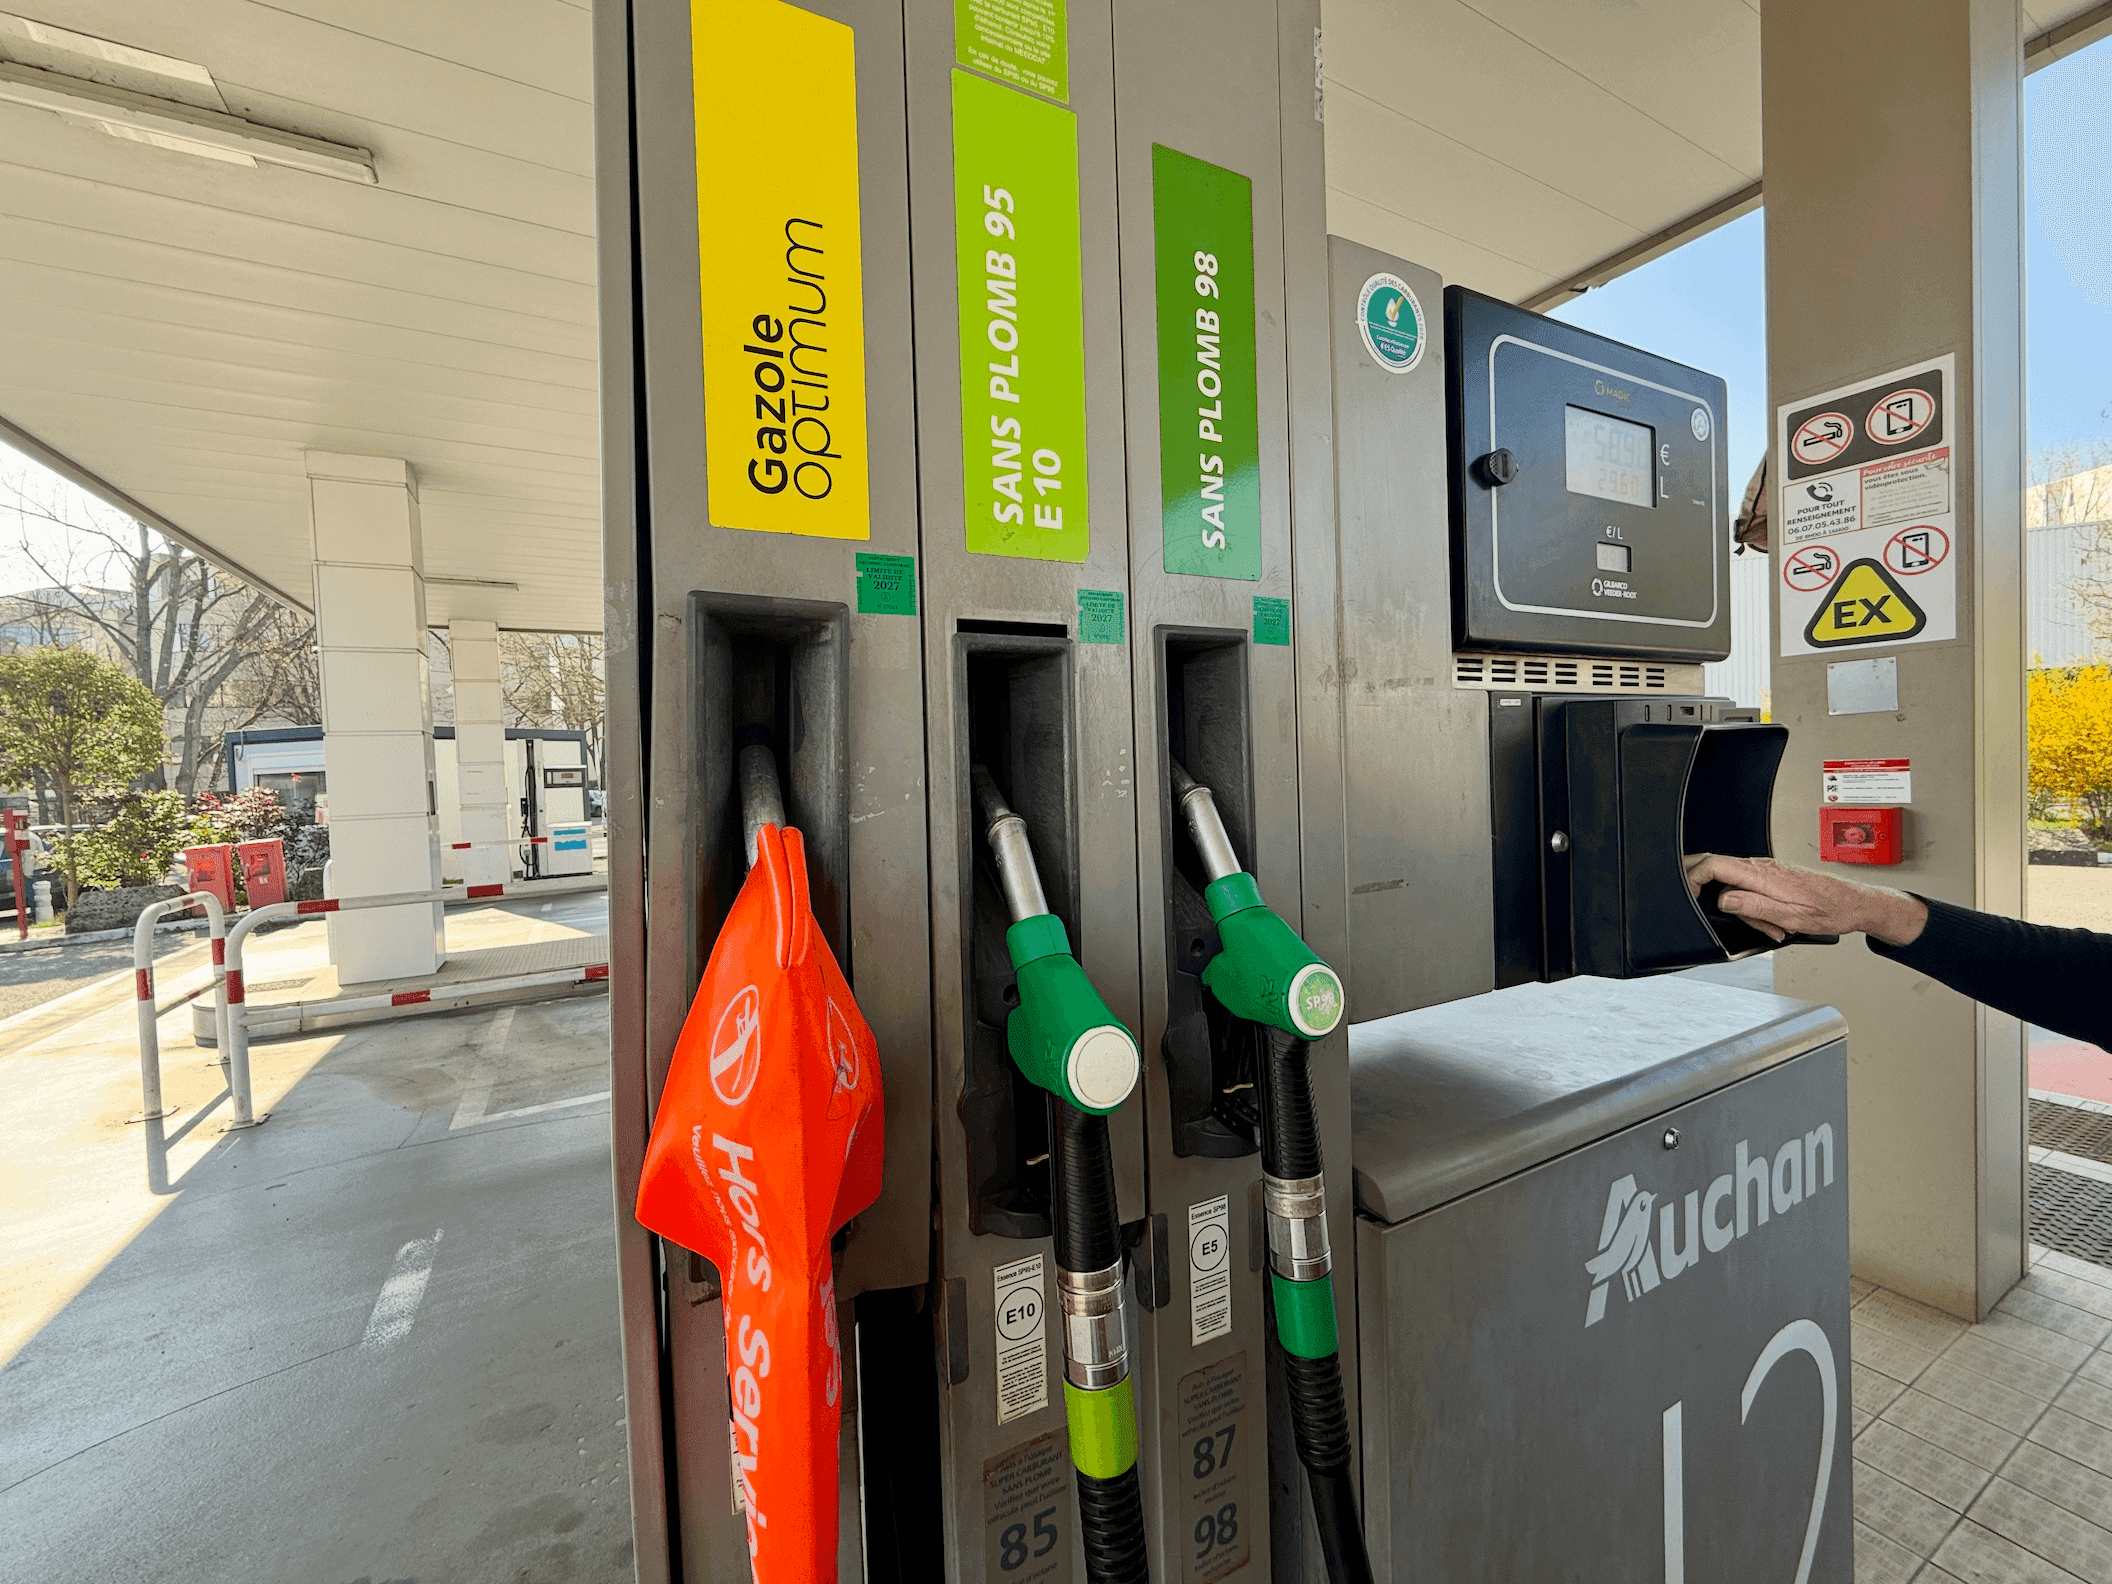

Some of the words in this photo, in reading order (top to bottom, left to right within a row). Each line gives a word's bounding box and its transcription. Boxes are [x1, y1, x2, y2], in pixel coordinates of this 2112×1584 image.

[983, 184, 1016, 240] 95
[1193, 250, 1219, 300] 98
[985, 250, 1020, 404] PLOMB
[785, 218, 842, 500] optimum
[1195, 307, 1223, 443] PLOMB
[743, 314, 788, 494] Gazole
[1032, 447, 1062, 490] 10
[1660, 444, 1670, 466] €
[990, 415, 1024, 526] SANS
[1864, 476, 1882, 484] vous
[1882, 472, 1899, 480] êtes
[1900, 468, 1918, 476] sous
[1200, 452, 1226, 550] SANS
[1660, 476, 1669, 499] L
[1034, 504, 1063, 530] E
[1786, 506, 1857, 526] RENSEIGNEMENT
[1797, 505, 1820, 516] POUR
[1822, 500, 1845, 510] TOUT
[1606, 525, 1624, 540] €/L
[1788, 515, 1856, 535] 06.07.05.43.86
[873, 580, 900, 590] 2027
[1604, 580, 1628, 590] GILBARCO
[1604, 588, 1638, 599] VEEDER-ROOT
[1092, 614, 1112, 622] 2027
[1834, 594, 1892, 629] EX
[712, 1132, 772, 1293] Hors
[1190, 1208, 1212, 1221] Essence
[1213, 1202, 1227, 1214] SP98
[1584, 1122, 1834, 1328] Auchan
[1202, 1240, 1218, 1256] E5
[996, 1270, 1018, 1283] Essence
[1018, 1262, 1042, 1276] SP95-E10
[1006, 1302, 1036, 1326] E10
[1193, 1423, 1236, 1480] 87
[990, 1472, 1015, 1489] SUPER
[1016, 1451, 1064, 1477] CARBURANT
[1002, 1480, 1024, 1496] SANS
[1025, 1467, 1052, 1486] PLOMB
[1000, 1506, 1058, 1572] 85
[1194, 1502, 1238, 1559] 98
